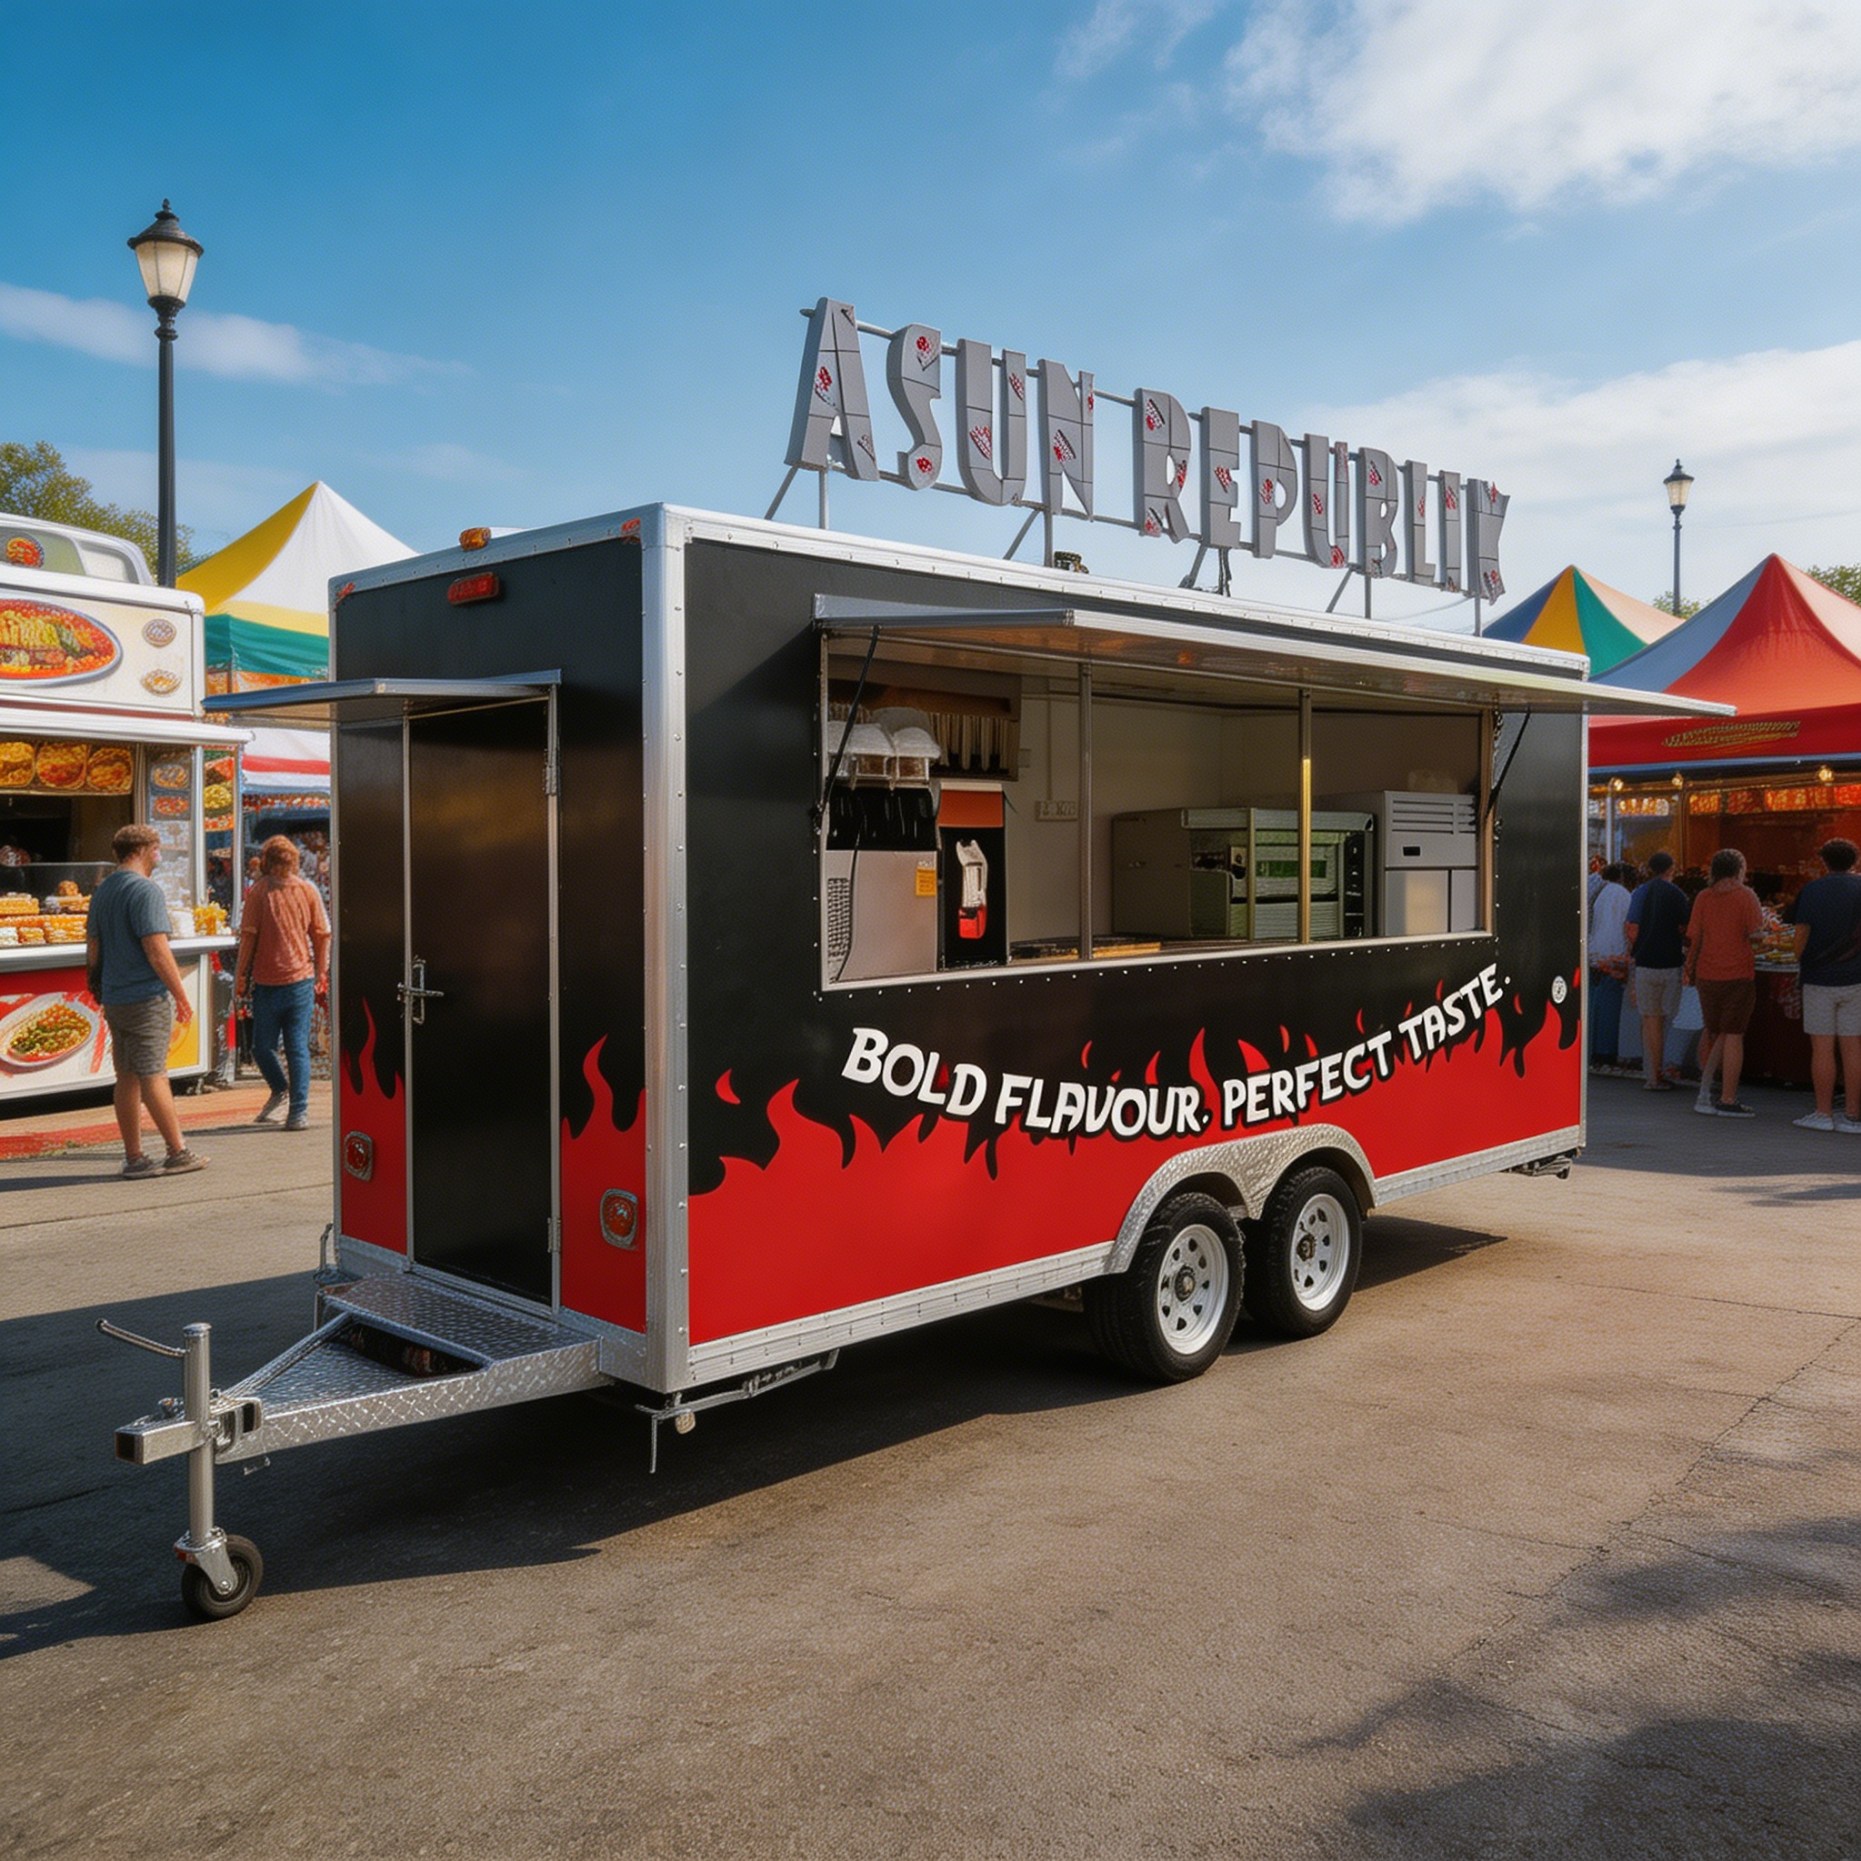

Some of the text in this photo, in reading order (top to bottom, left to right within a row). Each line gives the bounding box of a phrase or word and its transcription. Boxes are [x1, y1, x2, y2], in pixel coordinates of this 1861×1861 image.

[785, 297, 1094, 521] ASUN
[841, 1027, 987, 1116] BOLD
[1224, 1031, 1392, 1126] PERFECT
[1398, 963, 1511, 1060] TASTE.
